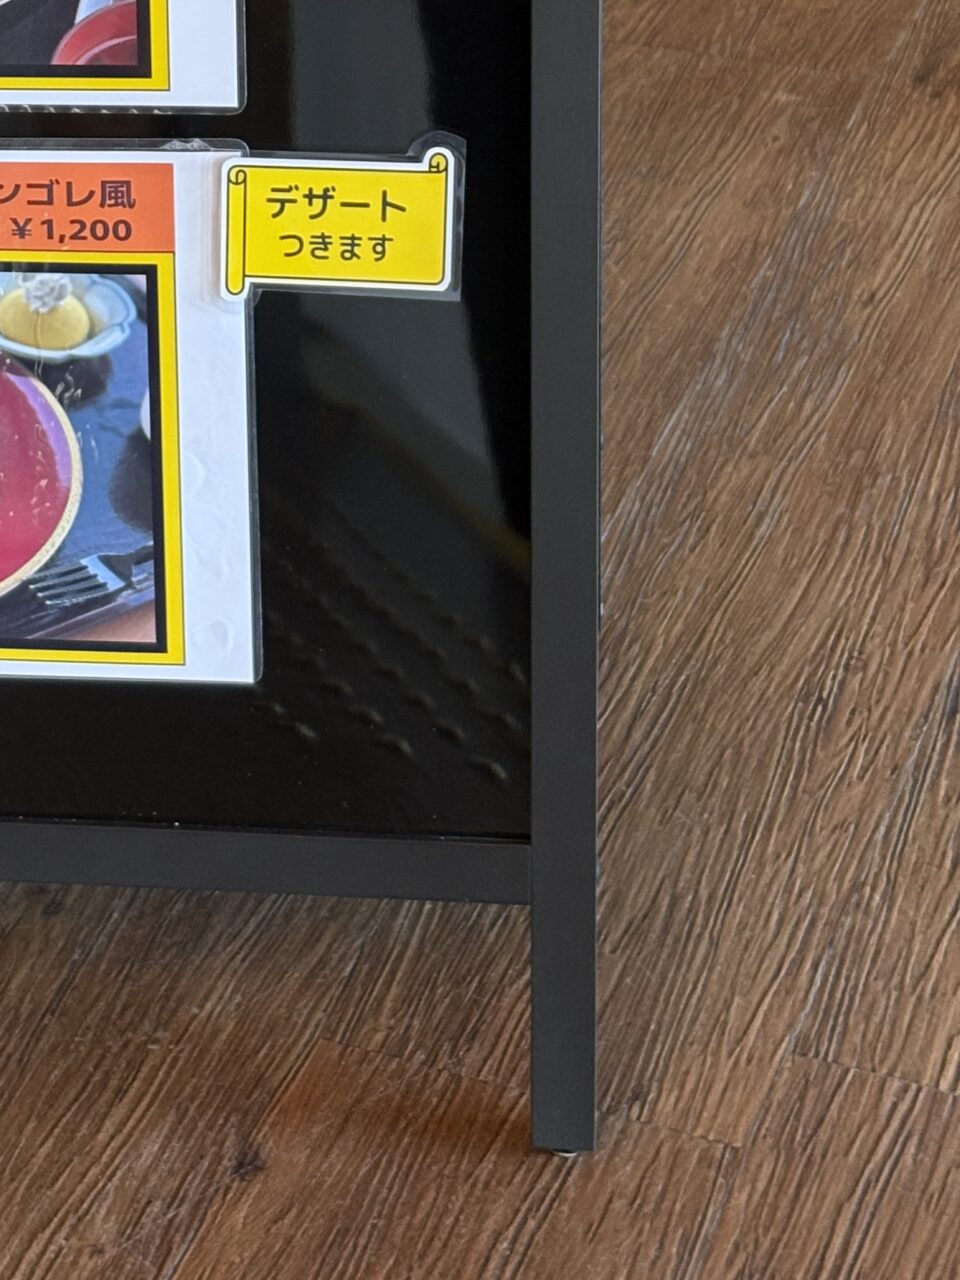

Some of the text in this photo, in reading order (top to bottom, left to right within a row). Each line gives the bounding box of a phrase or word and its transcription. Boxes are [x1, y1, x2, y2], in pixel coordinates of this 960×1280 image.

[265, 183, 408, 223] デザート
[9, 216, 134, 245] ¥1,200
[278, 231, 394, 263] つきます
